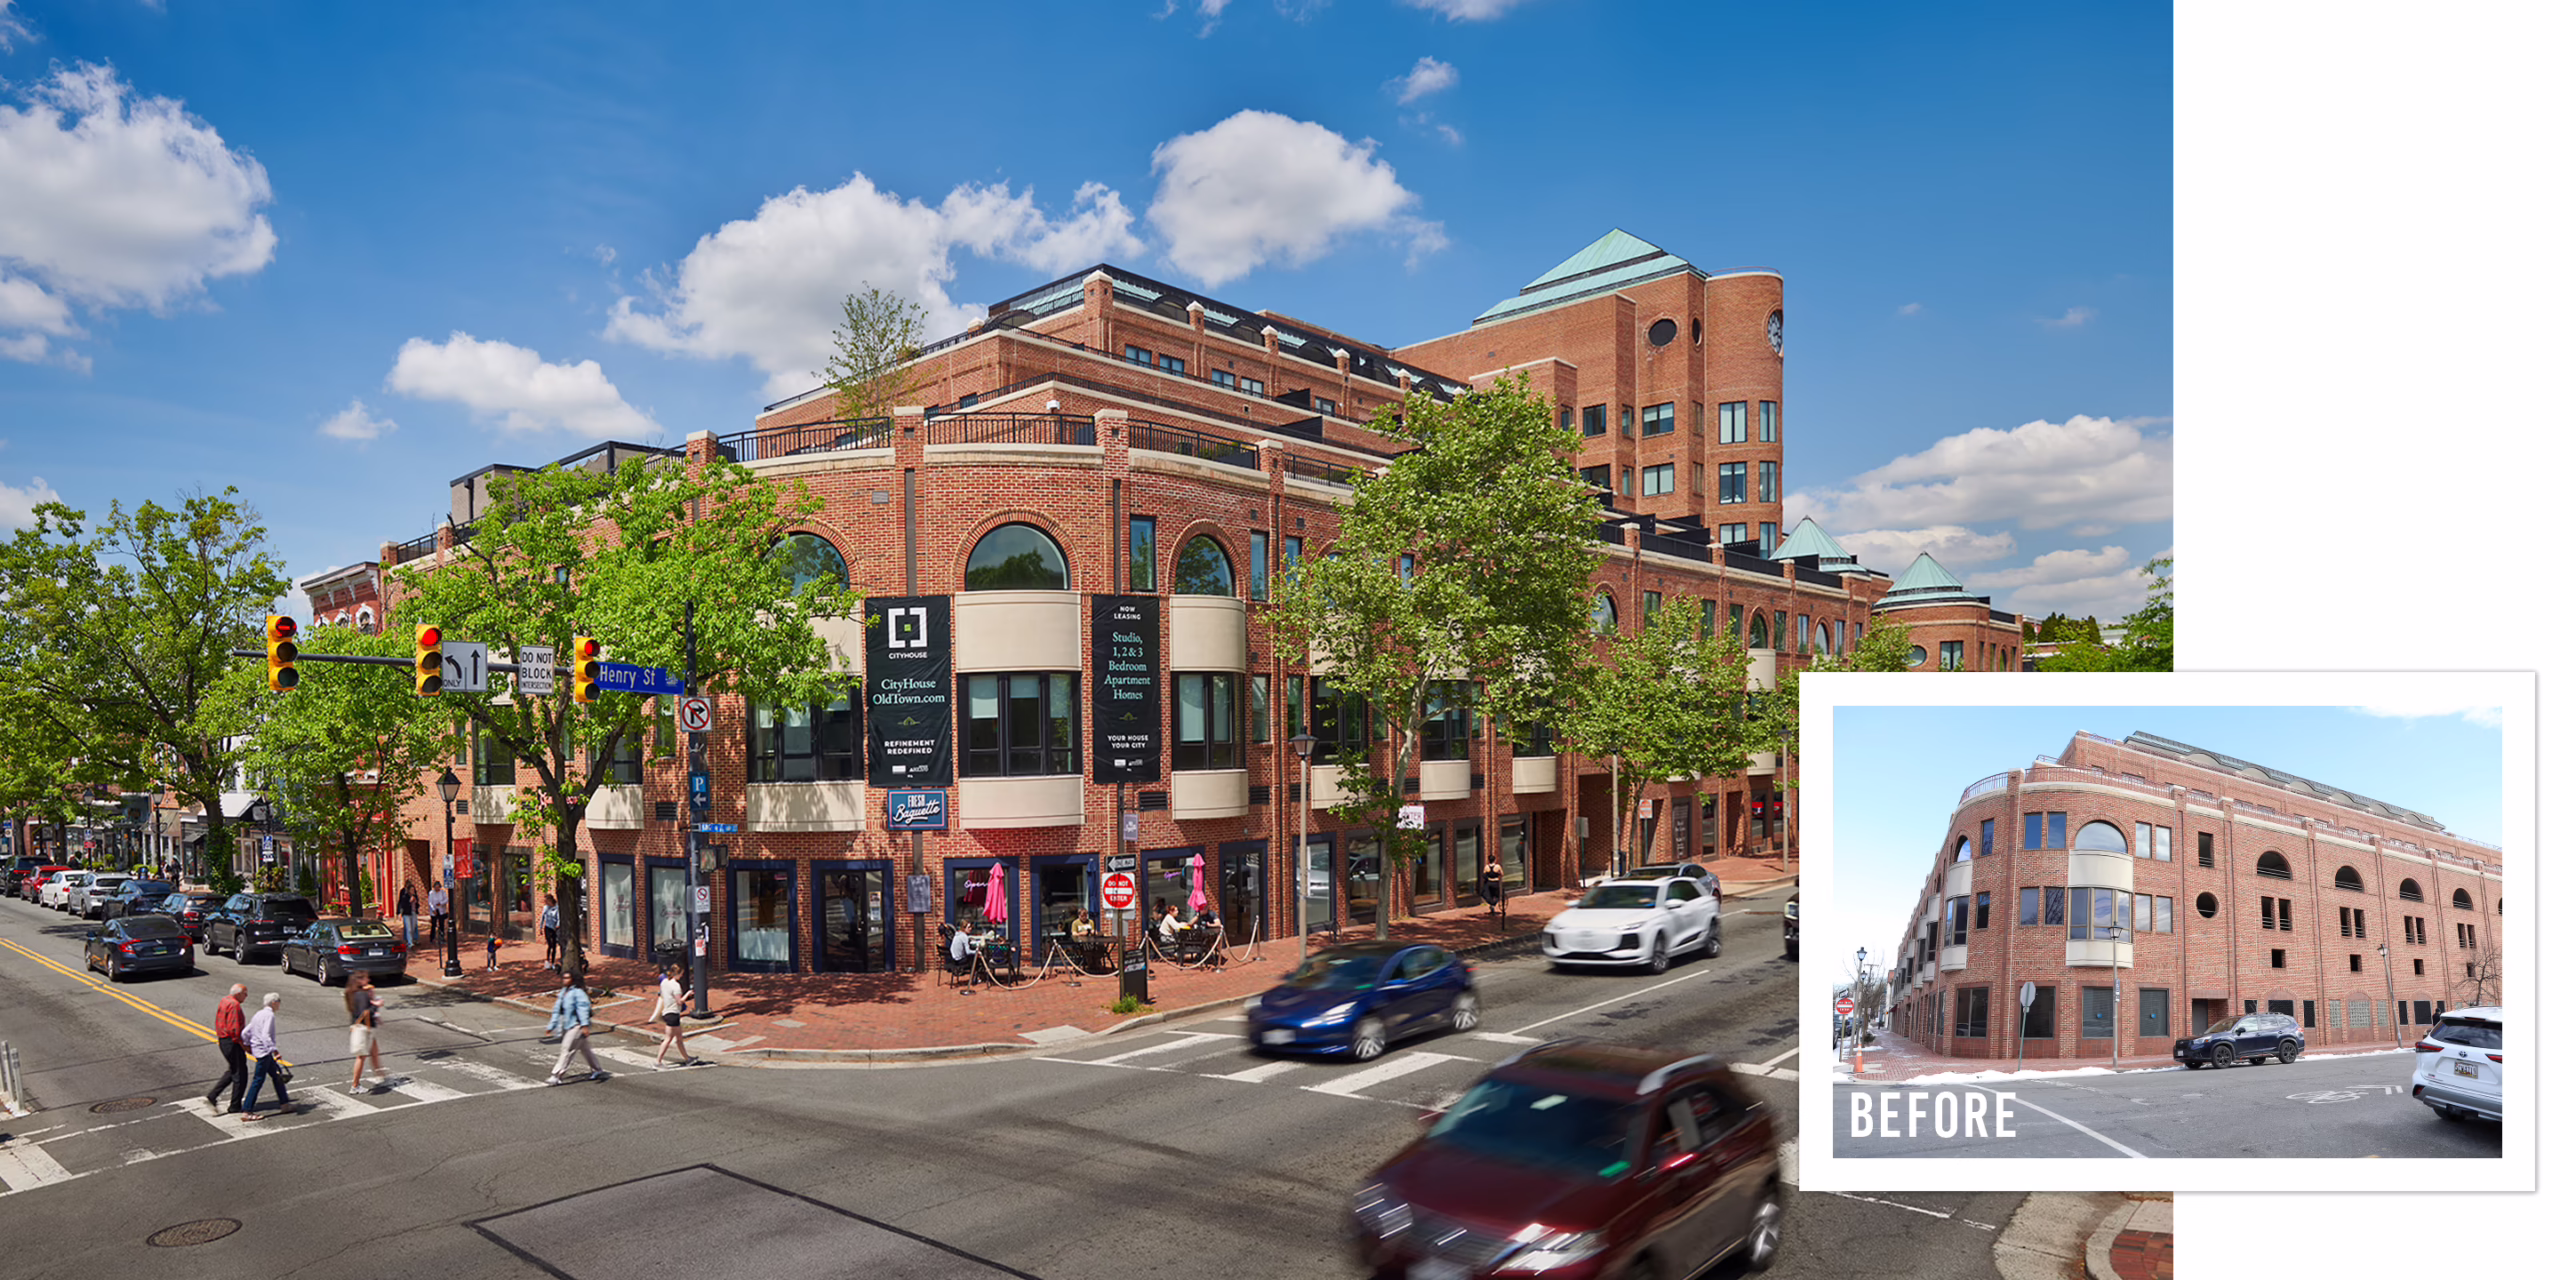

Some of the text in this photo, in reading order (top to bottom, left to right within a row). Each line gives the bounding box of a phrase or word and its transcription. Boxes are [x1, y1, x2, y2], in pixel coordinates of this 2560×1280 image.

[1112, 631, 1143, 645] Studio,
[521, 652, 553, 664] DO NOT
[1113, 647, 1121, 658] 1,
[1122, 647, 1128, 657] 2
[1138, 647, 1144, 657] 3
[1109, 661, 1147, 671] Bedroom
[521, 667, 552, 679] BLOCK
[600, 665, 656, 688] Henry St
[443, 679, 461, 688] ONLY
[881, 678, 936, 693] CityHouse
[1104, 675, 1151, 688] Apartment
[872, 693, 945, 705] OldTown.com
[1113, 689, 1144, 700] Homes
[695, 777, 704, 791] P
[907, 794, 926, 808] FRESH
[892, 799, 941, 825] Baguette
